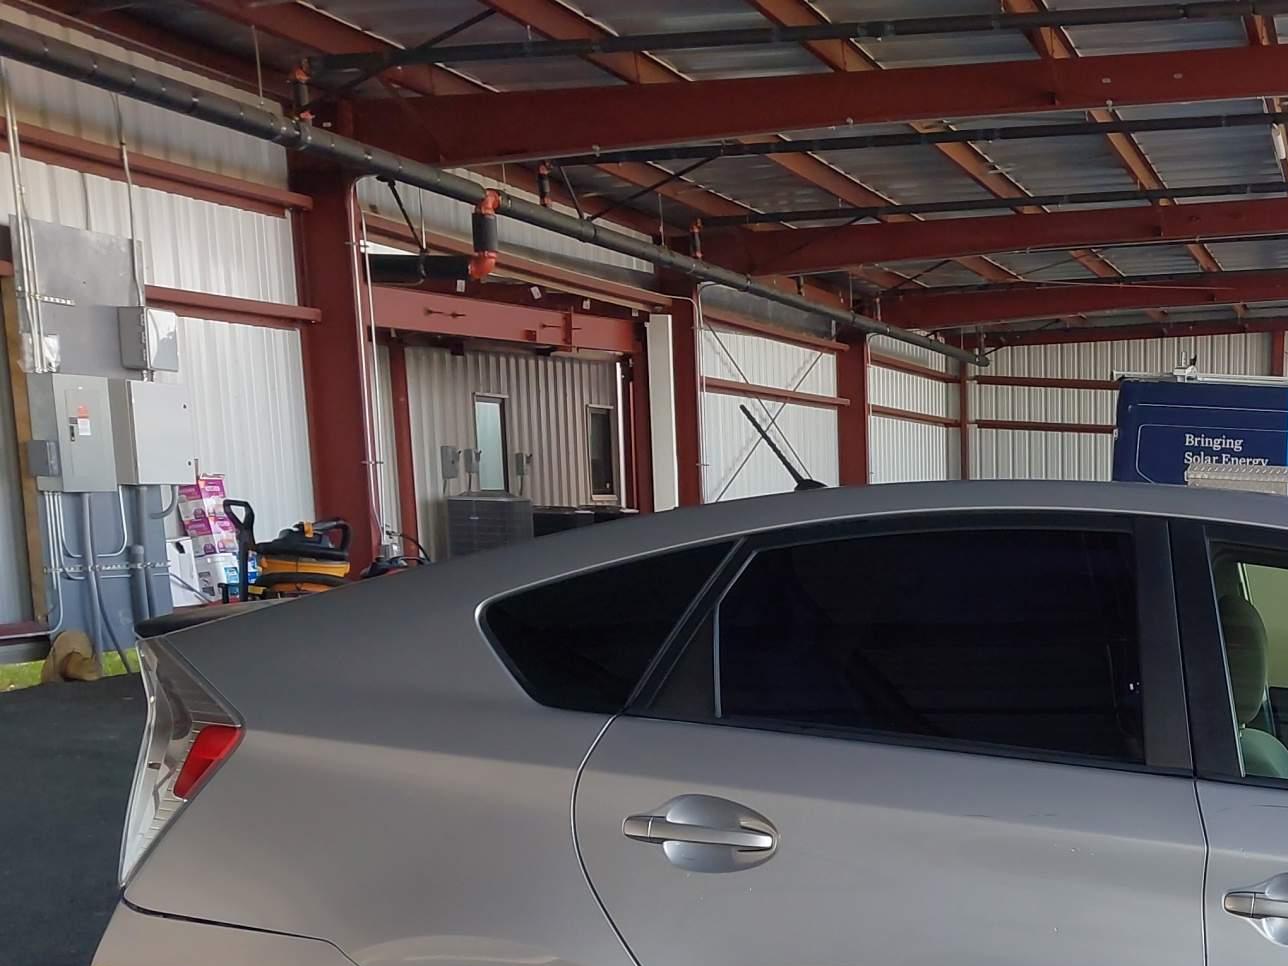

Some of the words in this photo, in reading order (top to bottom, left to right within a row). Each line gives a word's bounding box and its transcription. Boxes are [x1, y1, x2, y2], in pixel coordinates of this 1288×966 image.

[1184, 433, 1244, 452] Bringing
[1184, 452, 1219, 465] Solar
[1221, 453, 1269, 467] Energy
